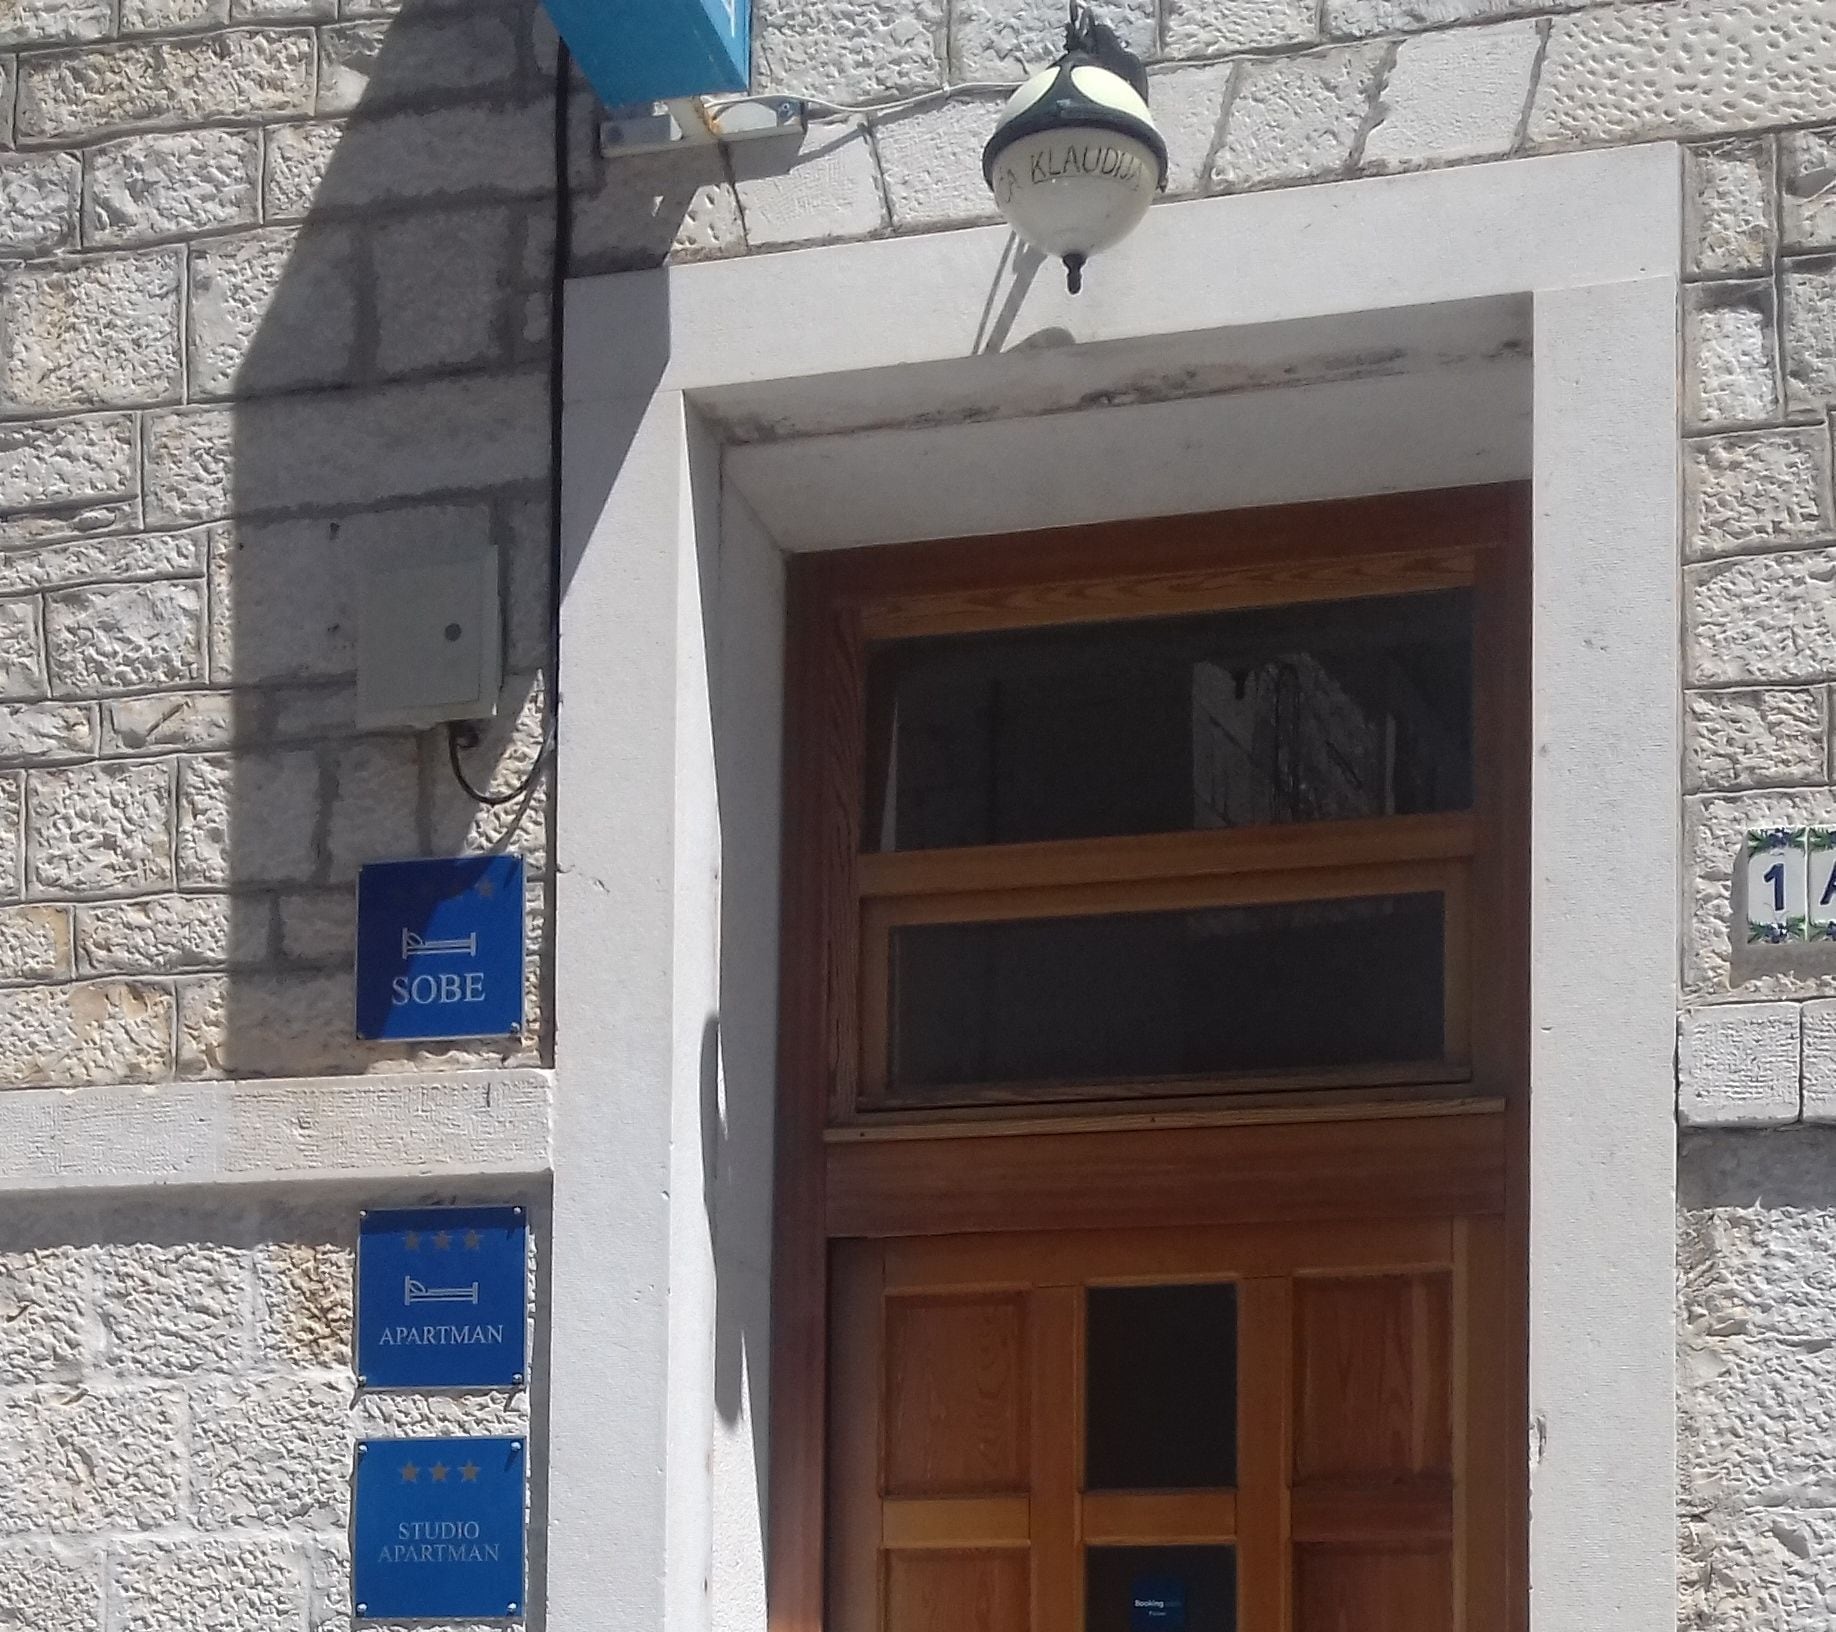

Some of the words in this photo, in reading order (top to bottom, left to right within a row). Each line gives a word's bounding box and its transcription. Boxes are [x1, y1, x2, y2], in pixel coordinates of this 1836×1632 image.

[392, 973, 486, 1005] SOBE
[379, 1325, 503, 1345] APARTMAN
[399, 1522, 480, 1540] STUDIO
[378, 1544, 499, 1562] APARTMAN
